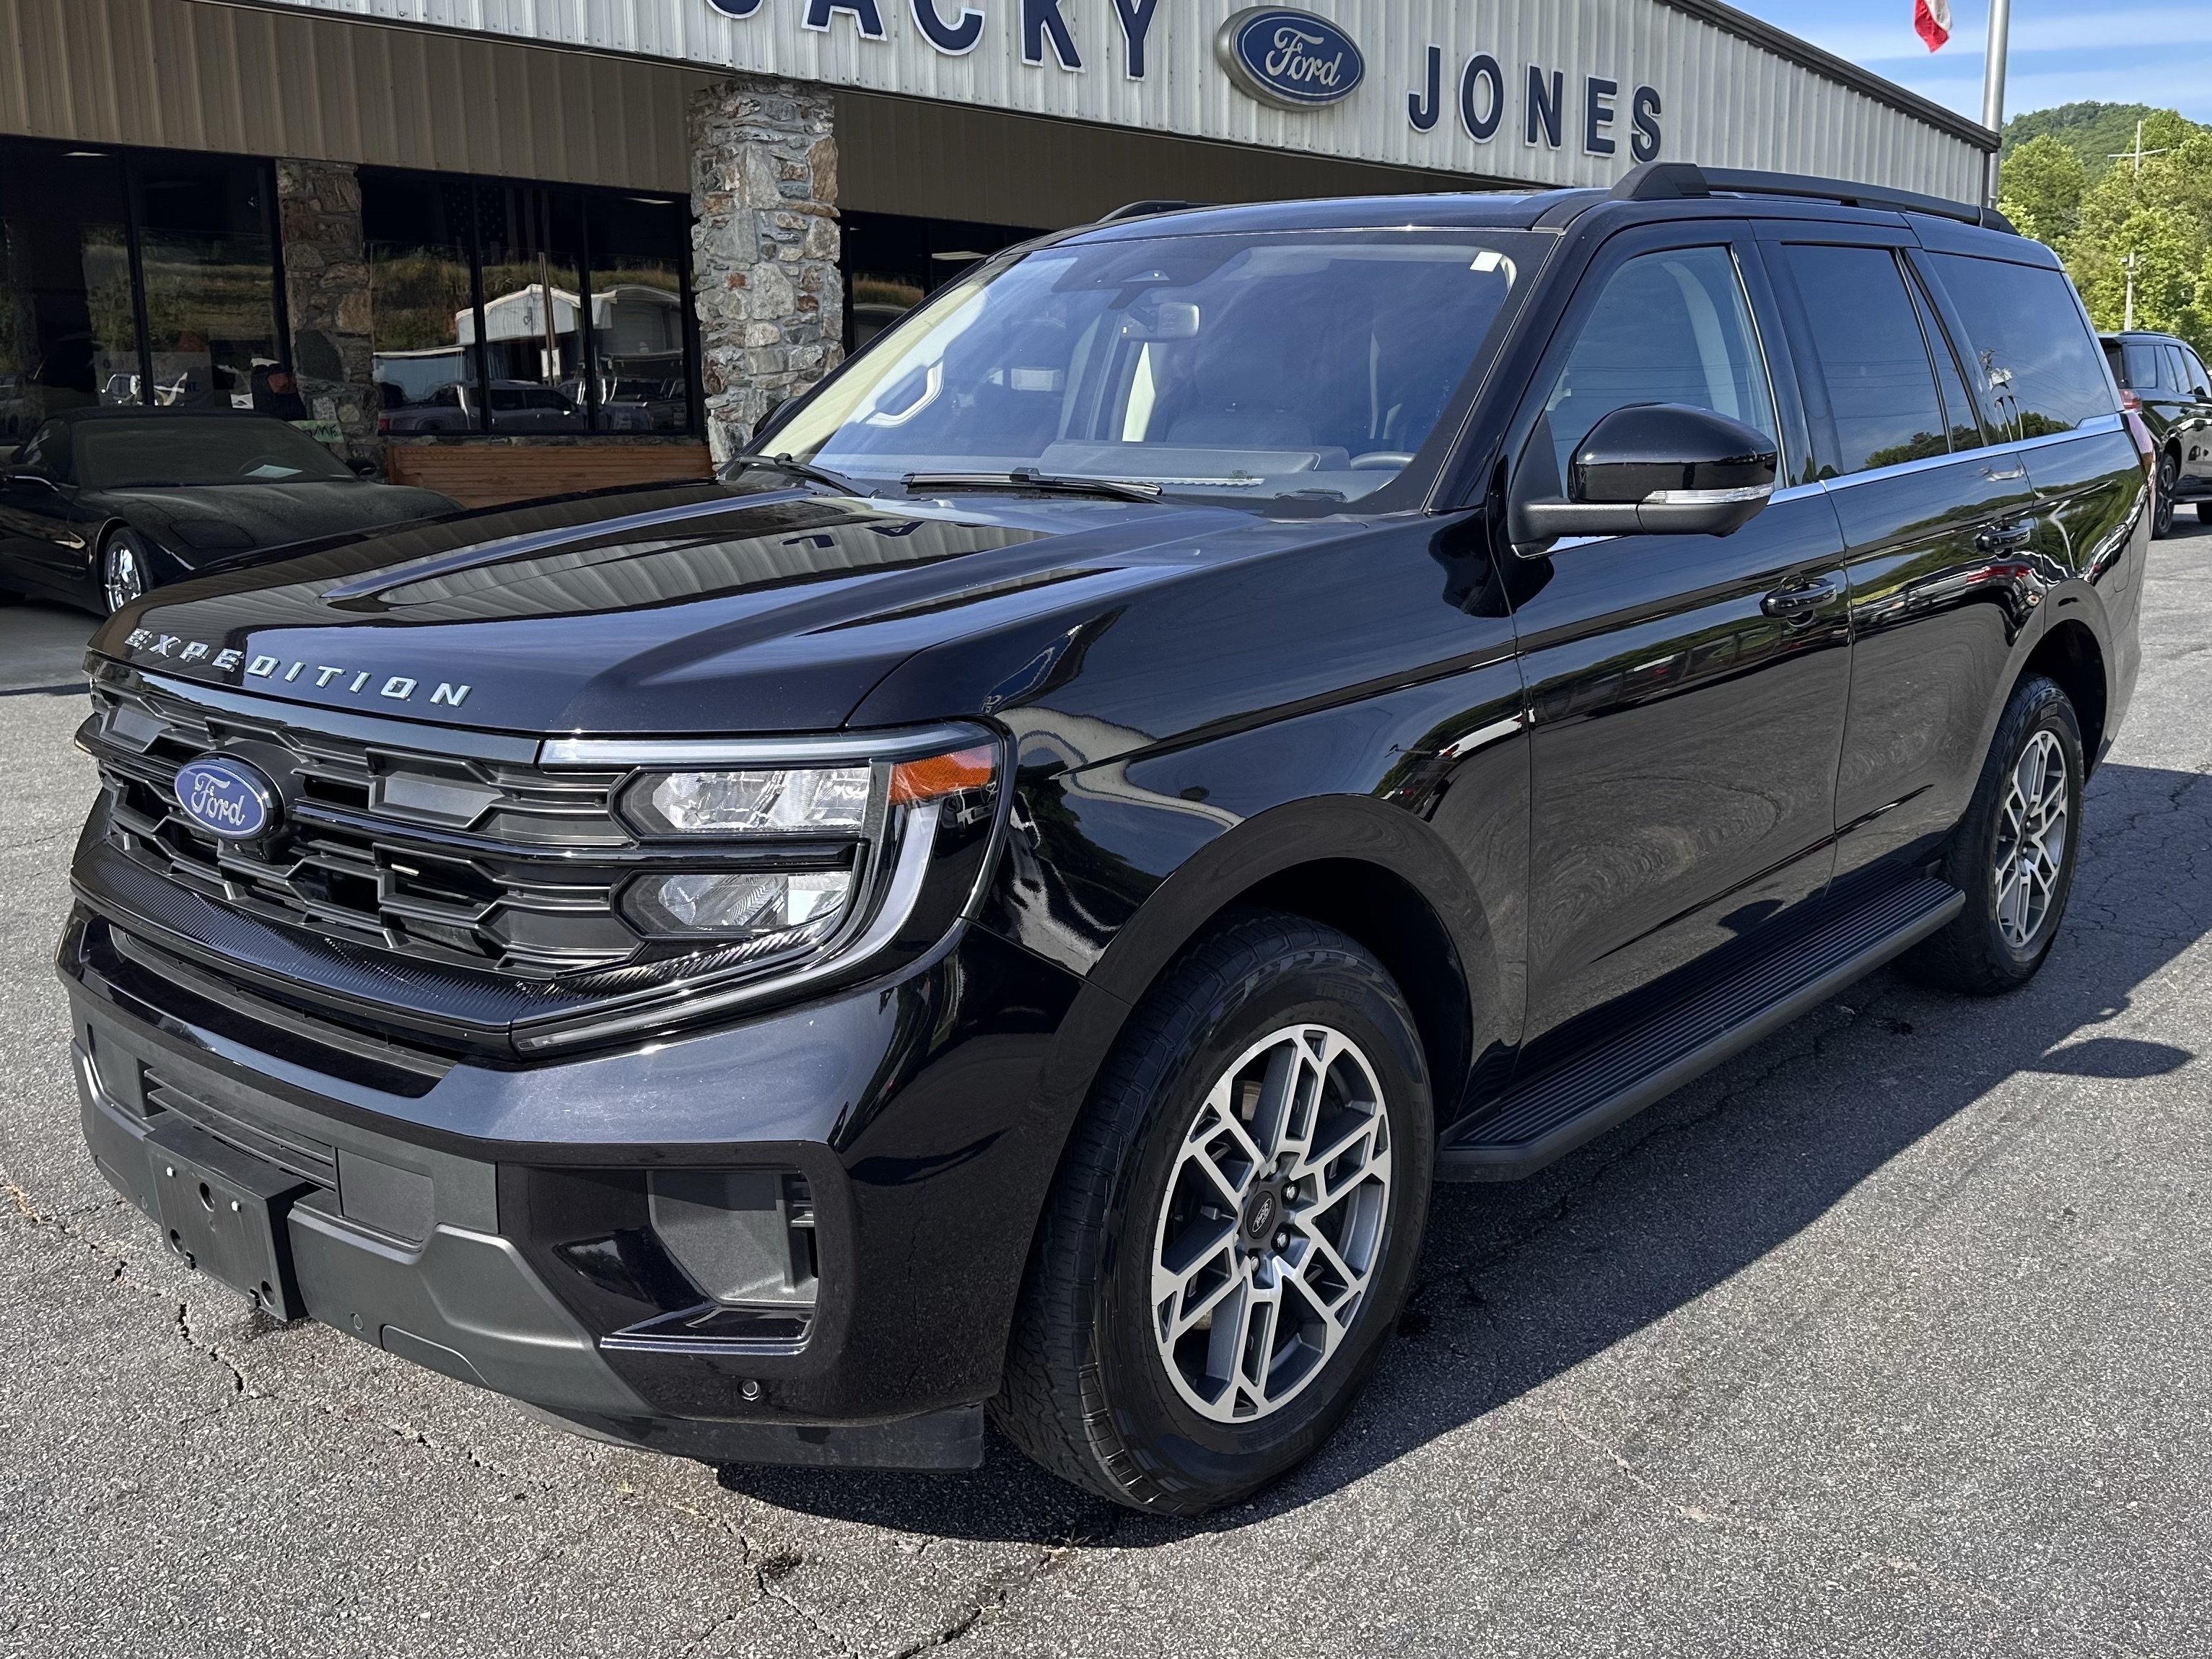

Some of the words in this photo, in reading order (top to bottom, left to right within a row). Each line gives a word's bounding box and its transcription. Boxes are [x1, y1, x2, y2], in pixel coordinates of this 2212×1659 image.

[707, 0, 1158, 81] CKY
[1265, 27, 1343, 87] Ford
[1407, 43, 1661, 163] JONES
[124, 627, 472, 708] EXPEDITION
[191, 772, 245, 826] Ford
